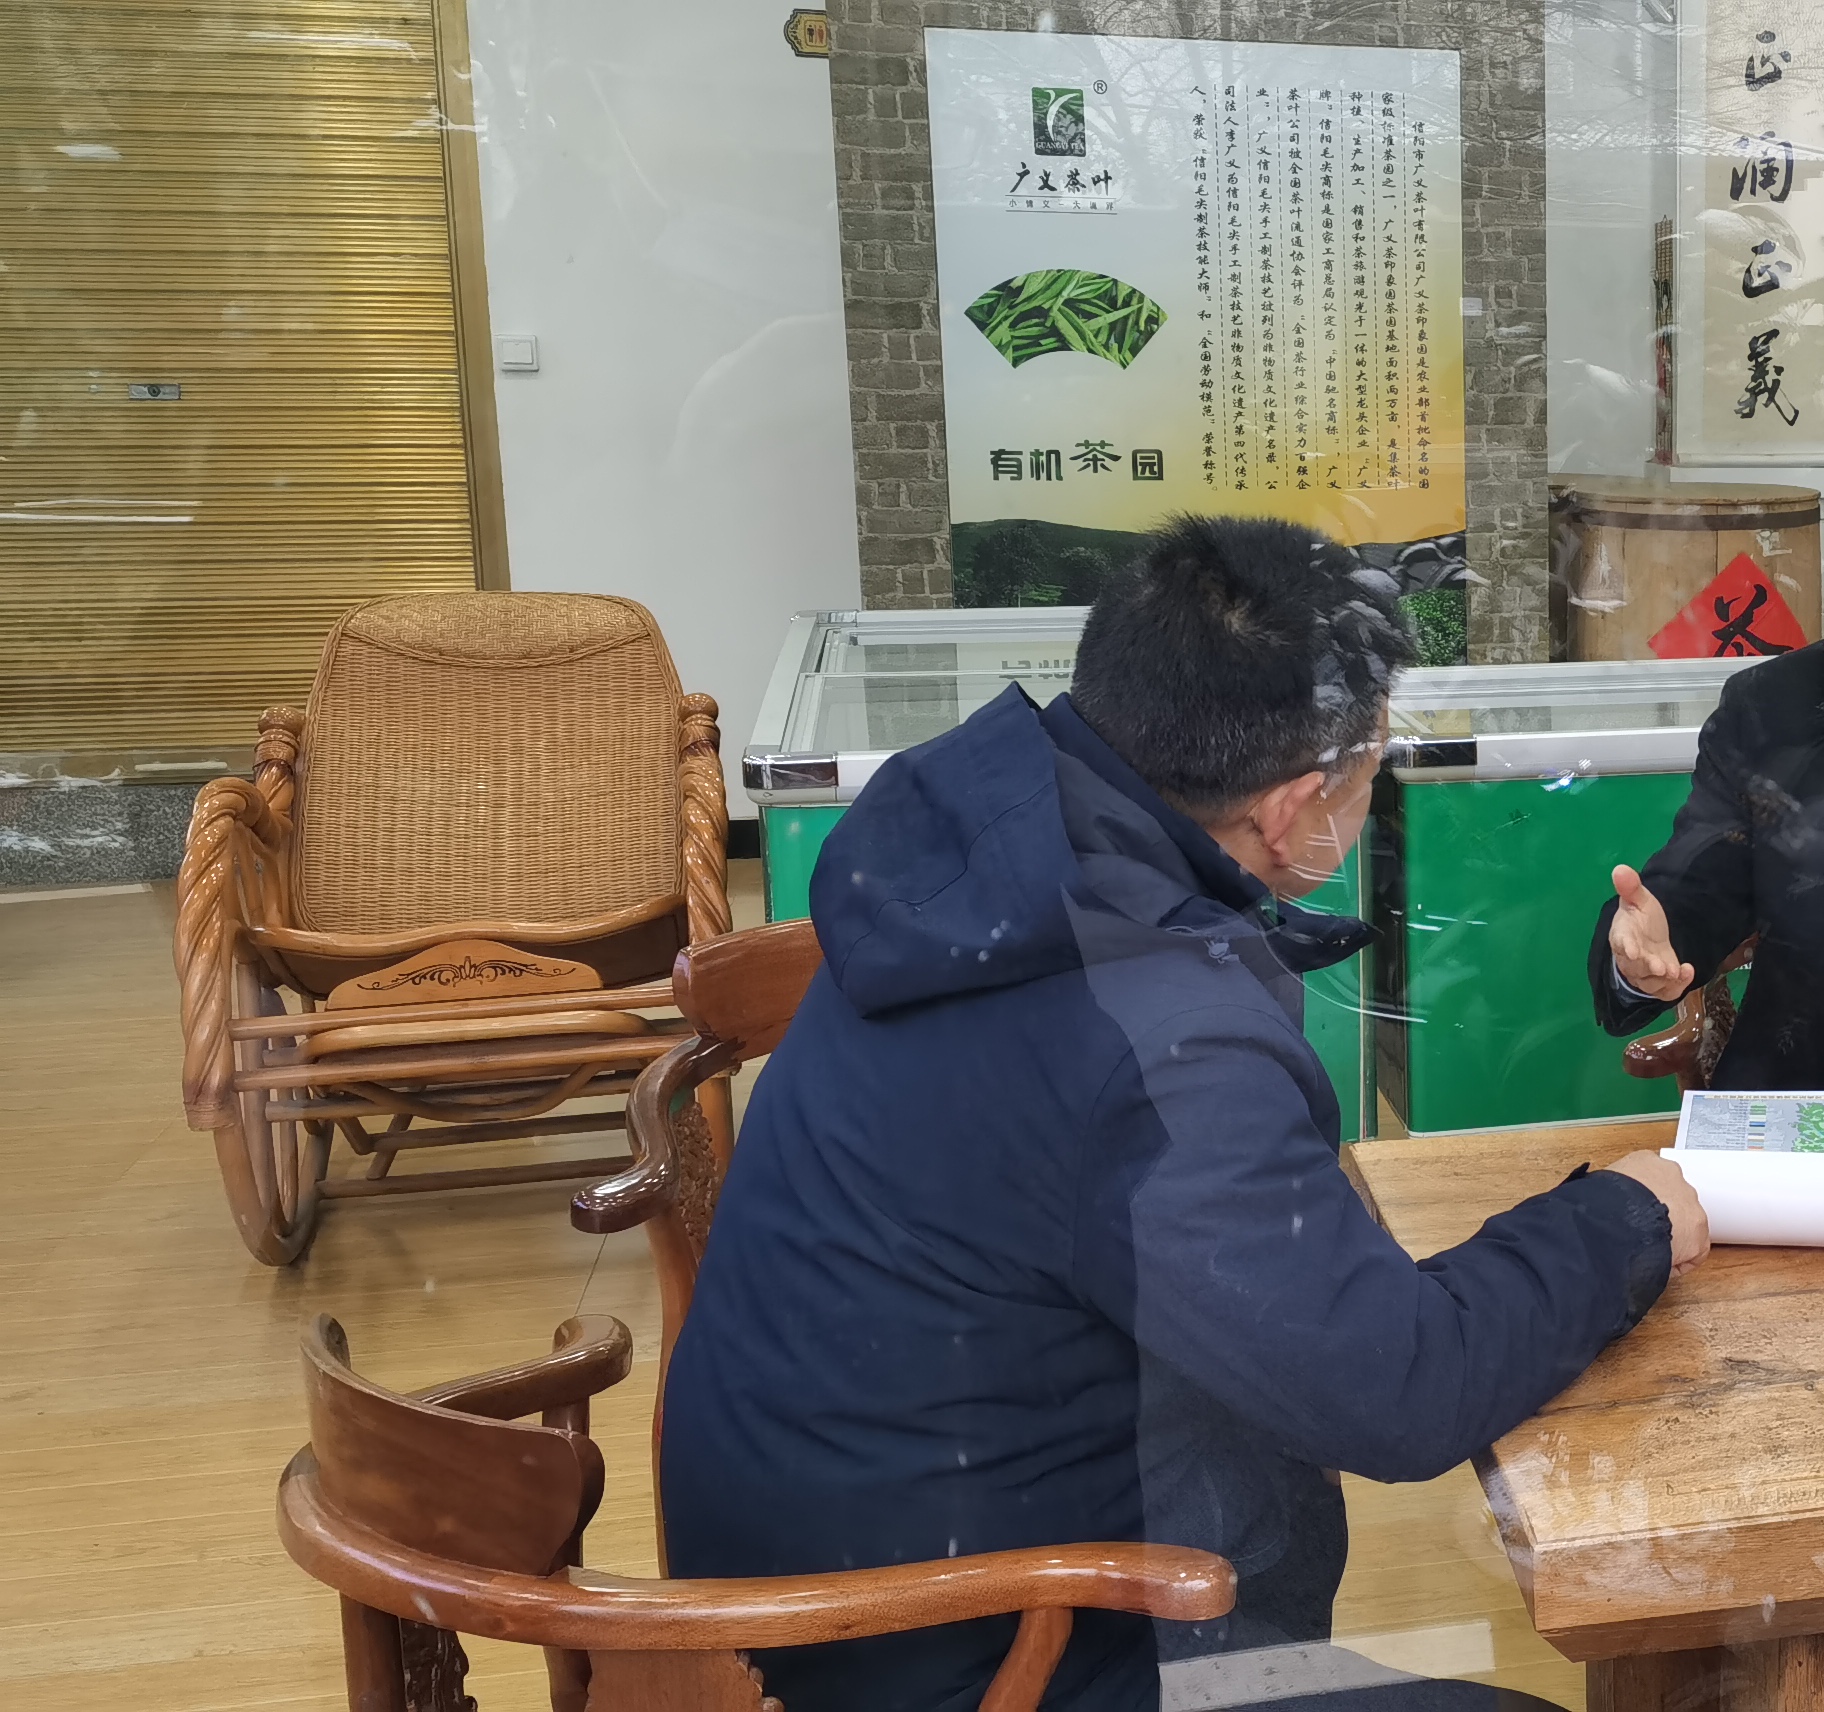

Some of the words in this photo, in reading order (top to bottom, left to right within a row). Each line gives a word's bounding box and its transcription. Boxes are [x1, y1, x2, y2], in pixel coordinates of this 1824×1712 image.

[1009, 161, 1113, 196] 广义茶叶
[989, 439, 1164, 483] 有机茶园
